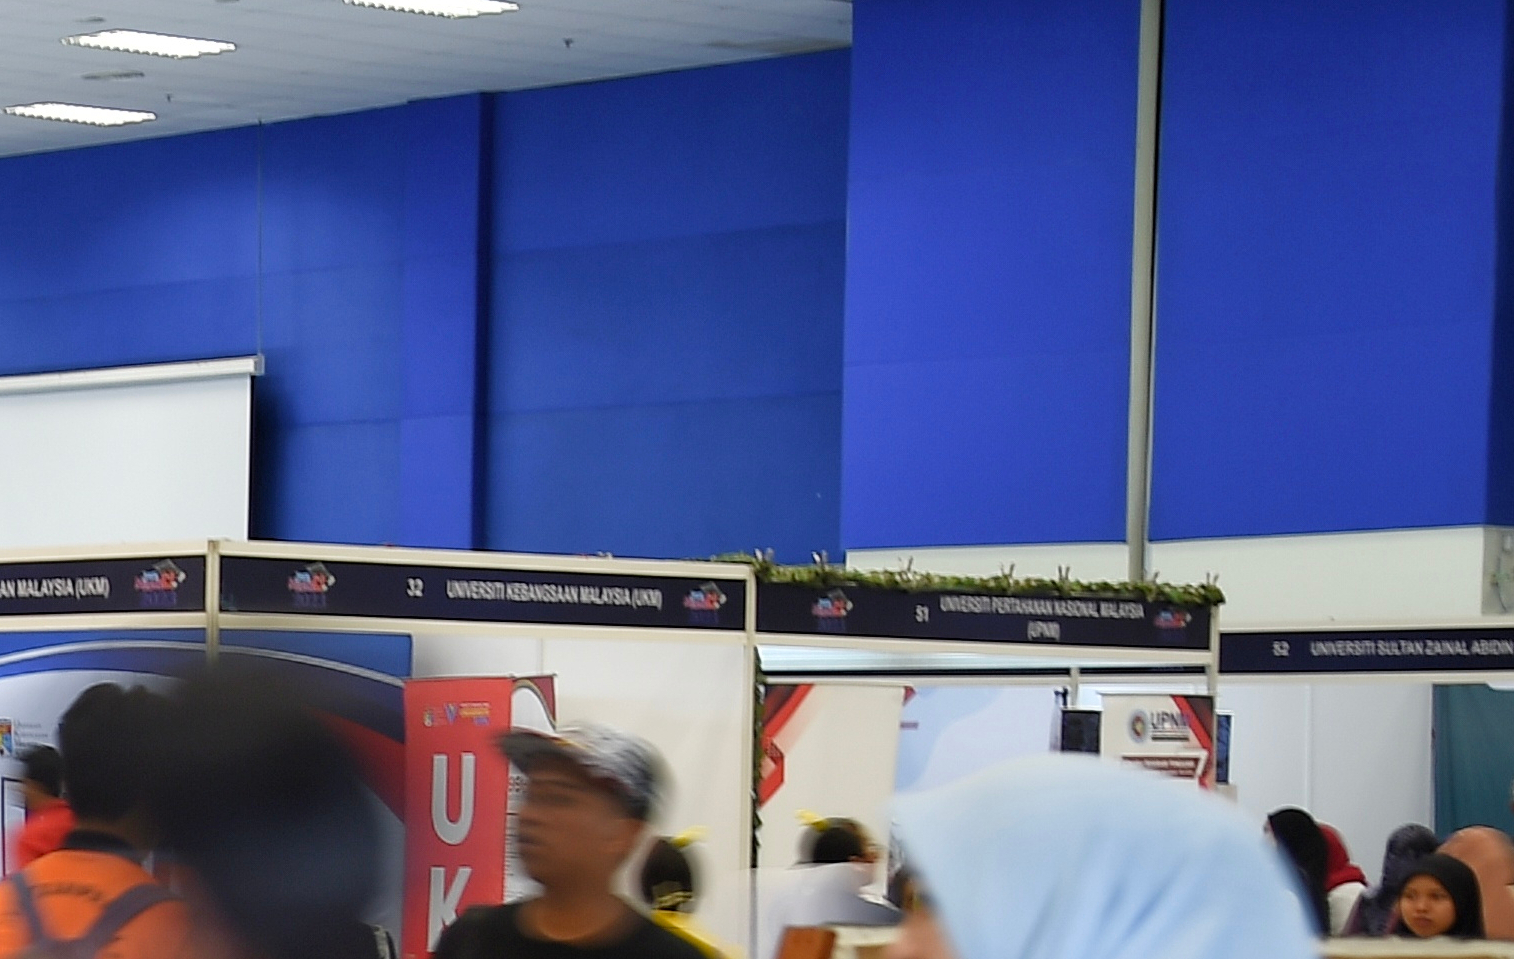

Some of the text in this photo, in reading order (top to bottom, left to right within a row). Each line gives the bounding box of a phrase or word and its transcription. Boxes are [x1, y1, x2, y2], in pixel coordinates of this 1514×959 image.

[16, 578, 73, 598] MALAYSIA
[75, 576, 110, 600] (UKM)
[406, 577, 424, 597] 32
[447, 579, 505, 600] UNIVERSITI
[506, 581, 579, 604] KEBANGSAAN
[579, 584, 631, 605] MALAYSIA
[940, 595, 990, 613] UNIVERSITI
[991, 596, 1053, 616] PERTAHANAN
[1054, 598, 1099, 617] NASIONAL
[1100, 601, 1145, 619] MALAYSIA
[1310, 640, 1375, 656] UNIVERSITI
[1376, 640, 1423, 656] SULTAN
[1424, 640, 1469, 656] ZAINAL
[1470, 639, 1514, 656] ABIDIN
